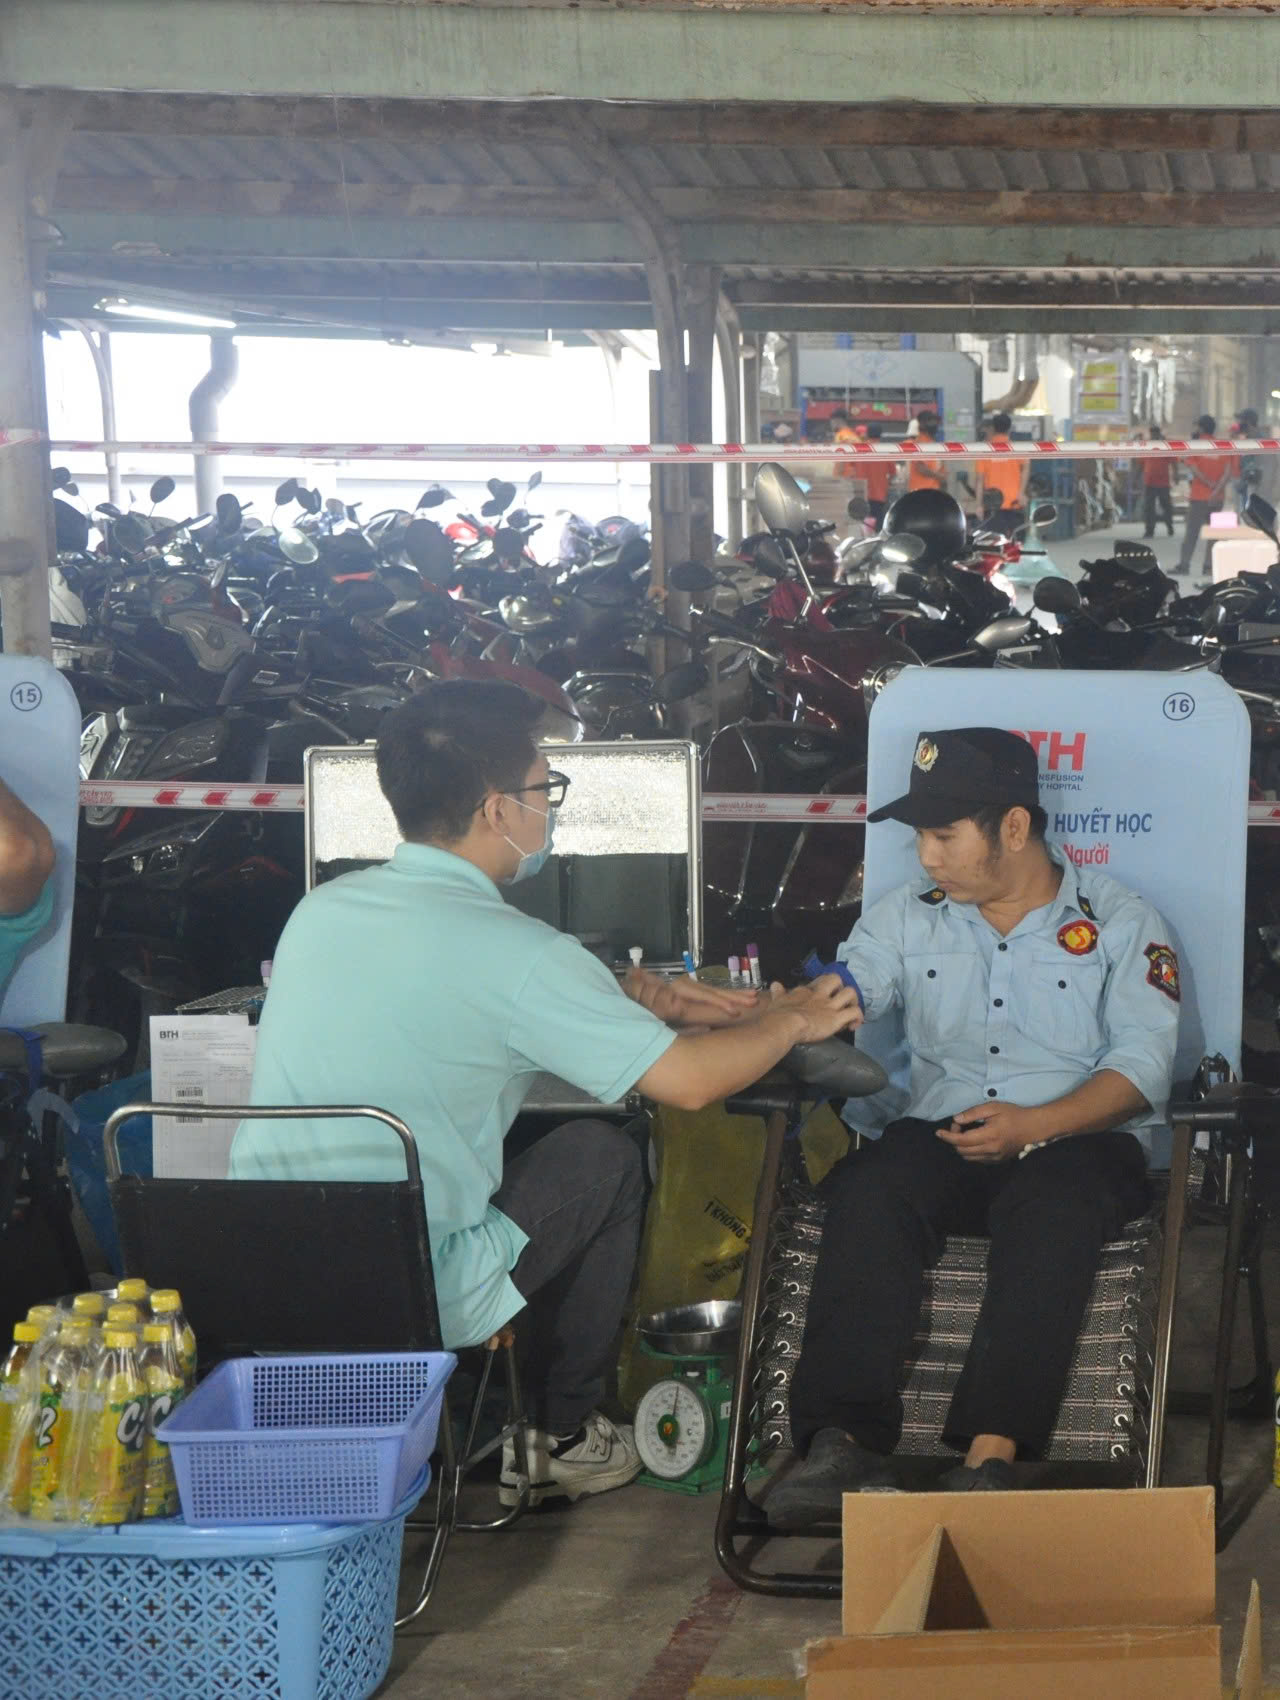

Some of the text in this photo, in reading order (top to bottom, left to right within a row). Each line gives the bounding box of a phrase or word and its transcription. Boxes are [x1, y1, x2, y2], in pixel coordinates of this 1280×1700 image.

[15, 688, 38, 705] 15
[1167, 699, 1190, 714] 16
[1008, 730, 1087, 771] TH
[1039, 774, 1084, 782] NSFUSION
[1046, 783, 1082, 791] HOPITAL
[1054, 807, 1153, 838] HUYẾT HỌC
[159, 1030, 179, 1040] BTH
